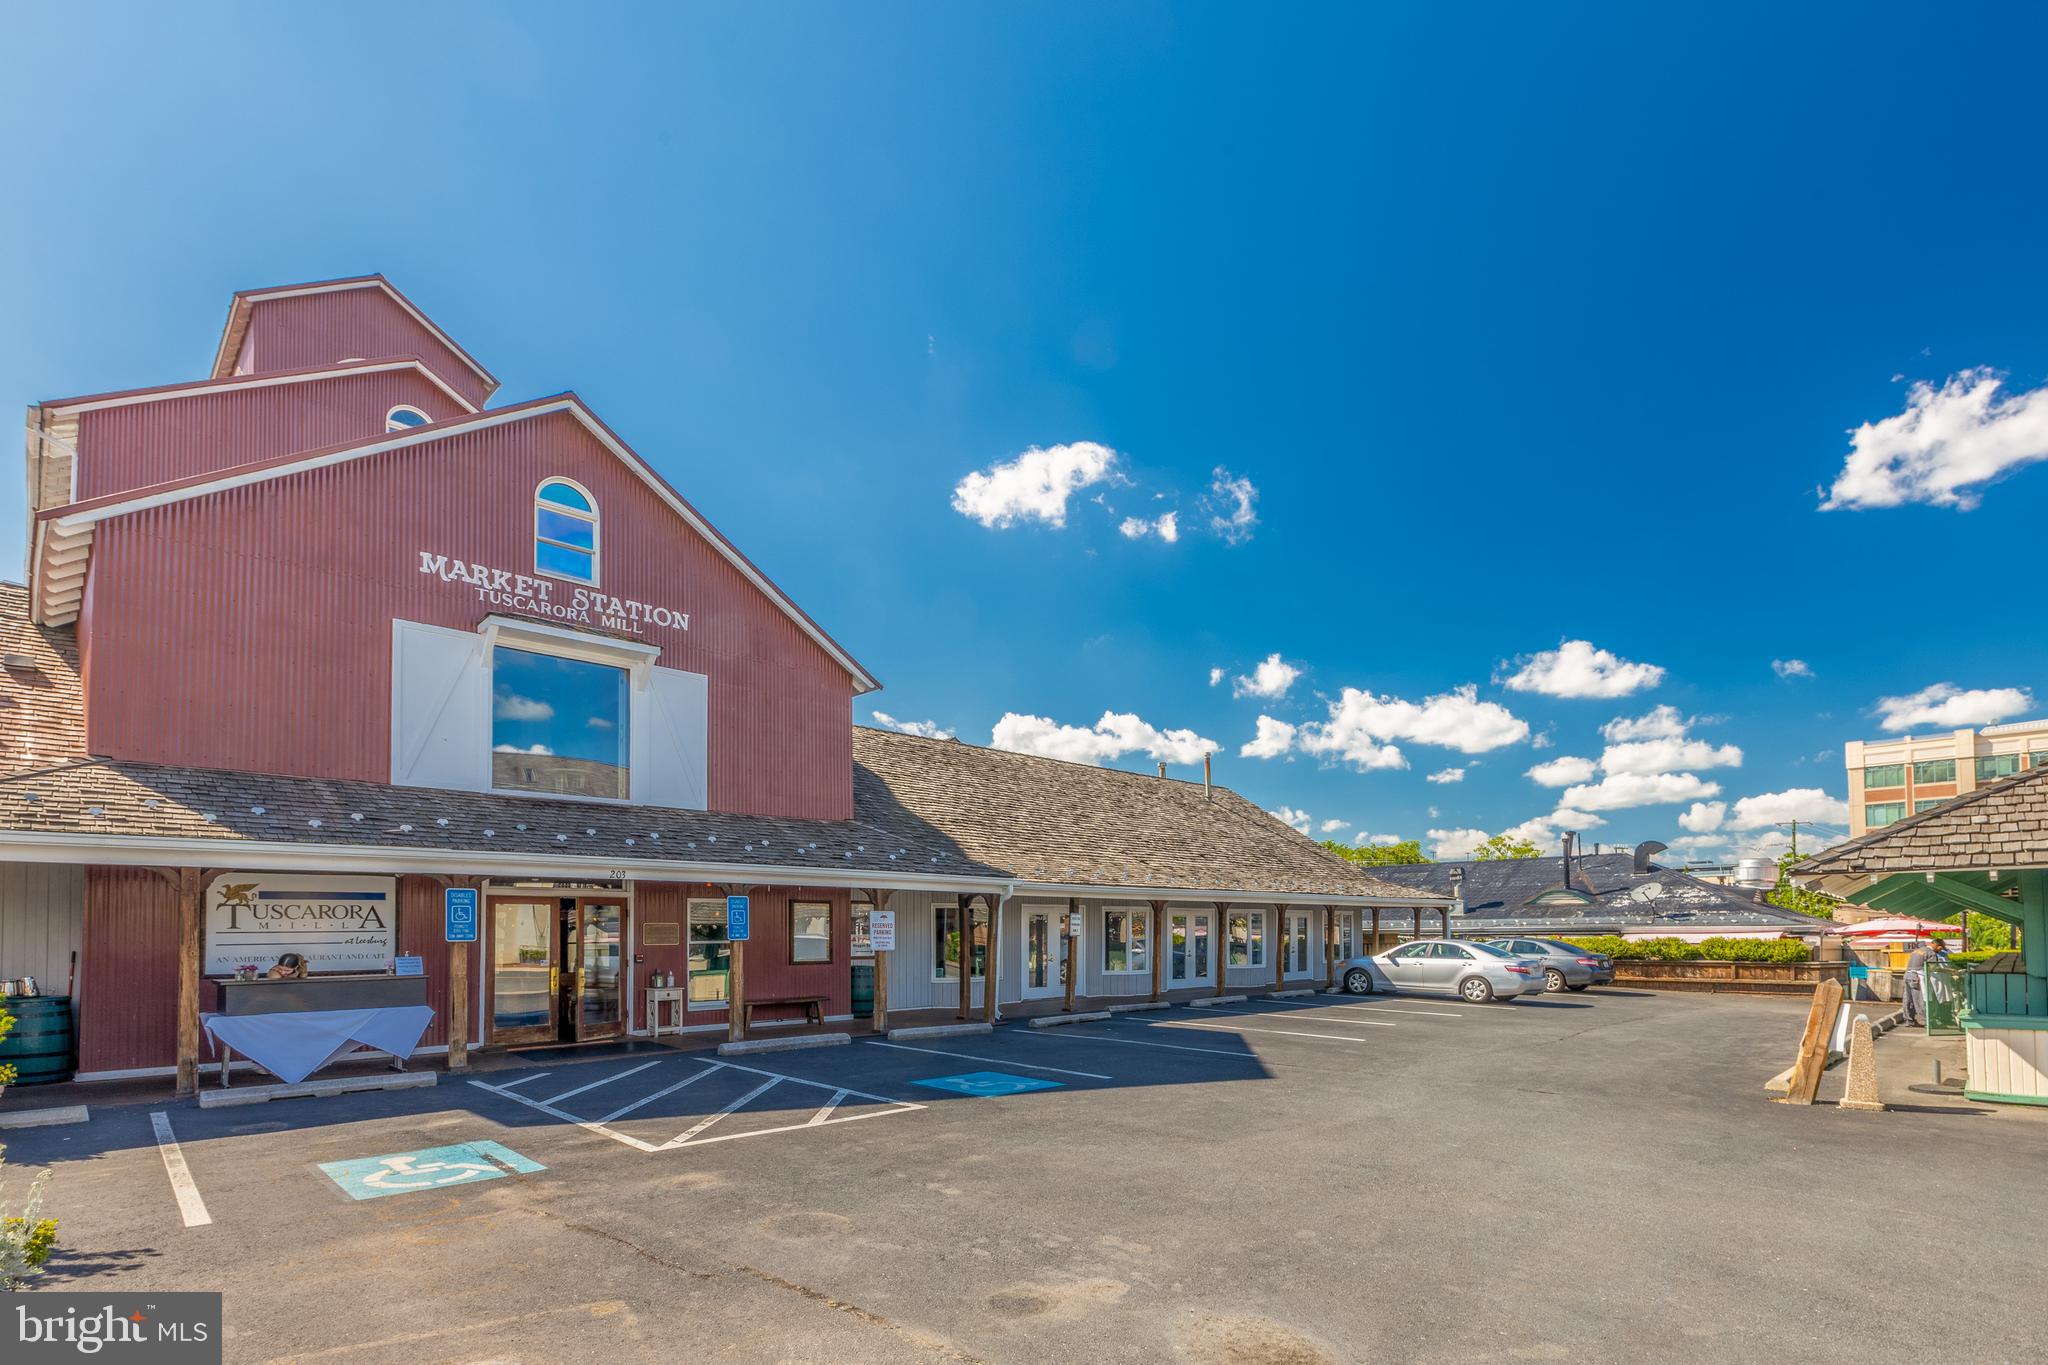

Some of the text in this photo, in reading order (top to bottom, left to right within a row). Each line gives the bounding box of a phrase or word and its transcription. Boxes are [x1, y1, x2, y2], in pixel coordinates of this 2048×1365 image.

[419, 551, 690, 631] MARKET STATION
[474, 587, 643, 634] TUSCARORA MILL
[609, 870, 626, 879] 203
[216, 903, 387, 929] TUSCARORA
[355, 935, 387, 947] Leesburg
[307, 953, 343, 961] AURANT
[345, 952, 364, 960] AND
